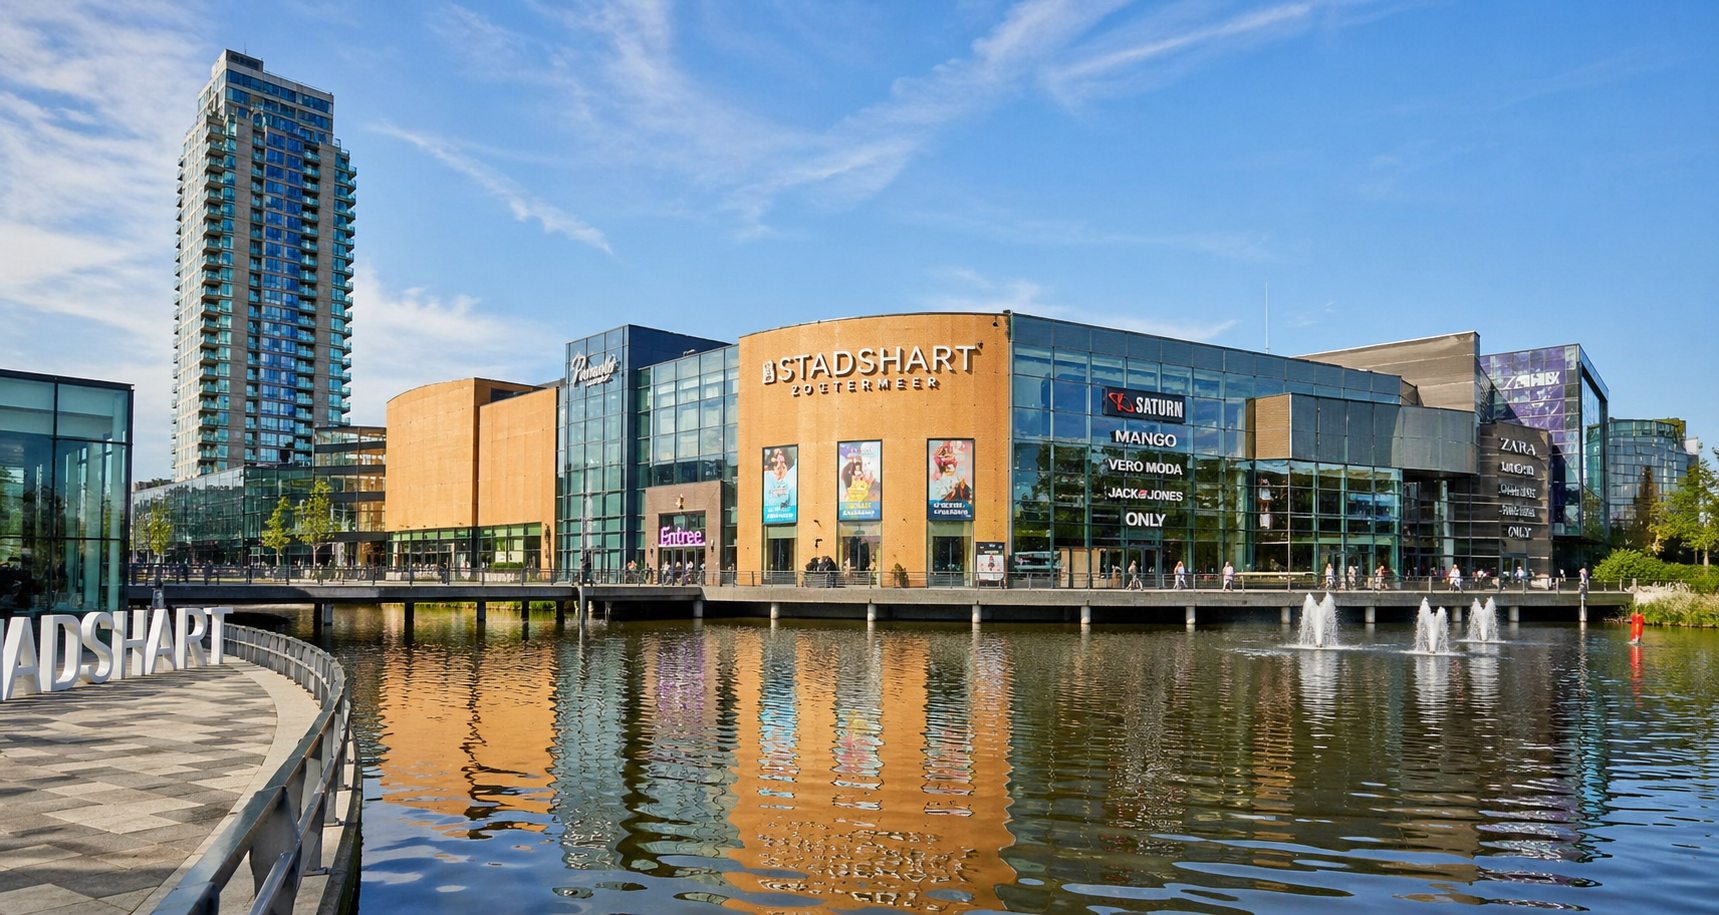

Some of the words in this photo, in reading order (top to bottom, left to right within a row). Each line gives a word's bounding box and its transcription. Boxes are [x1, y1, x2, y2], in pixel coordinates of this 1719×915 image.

[778, 345, 976, 382] STADSHART
[1136, 396, 1183, 418] SATURN
[1115, 429, 1177, 448] MANGO
[1500, 437, 1536, 456] ZARA
[1107, 458, 1144, 473] VERO
[1146, 461, 1183, 476] MODA
[1125, 512, 1166, 527] ONLY
[660, 526, 702, 546] Entree
[0, 607, 234, 700] ADSHART
